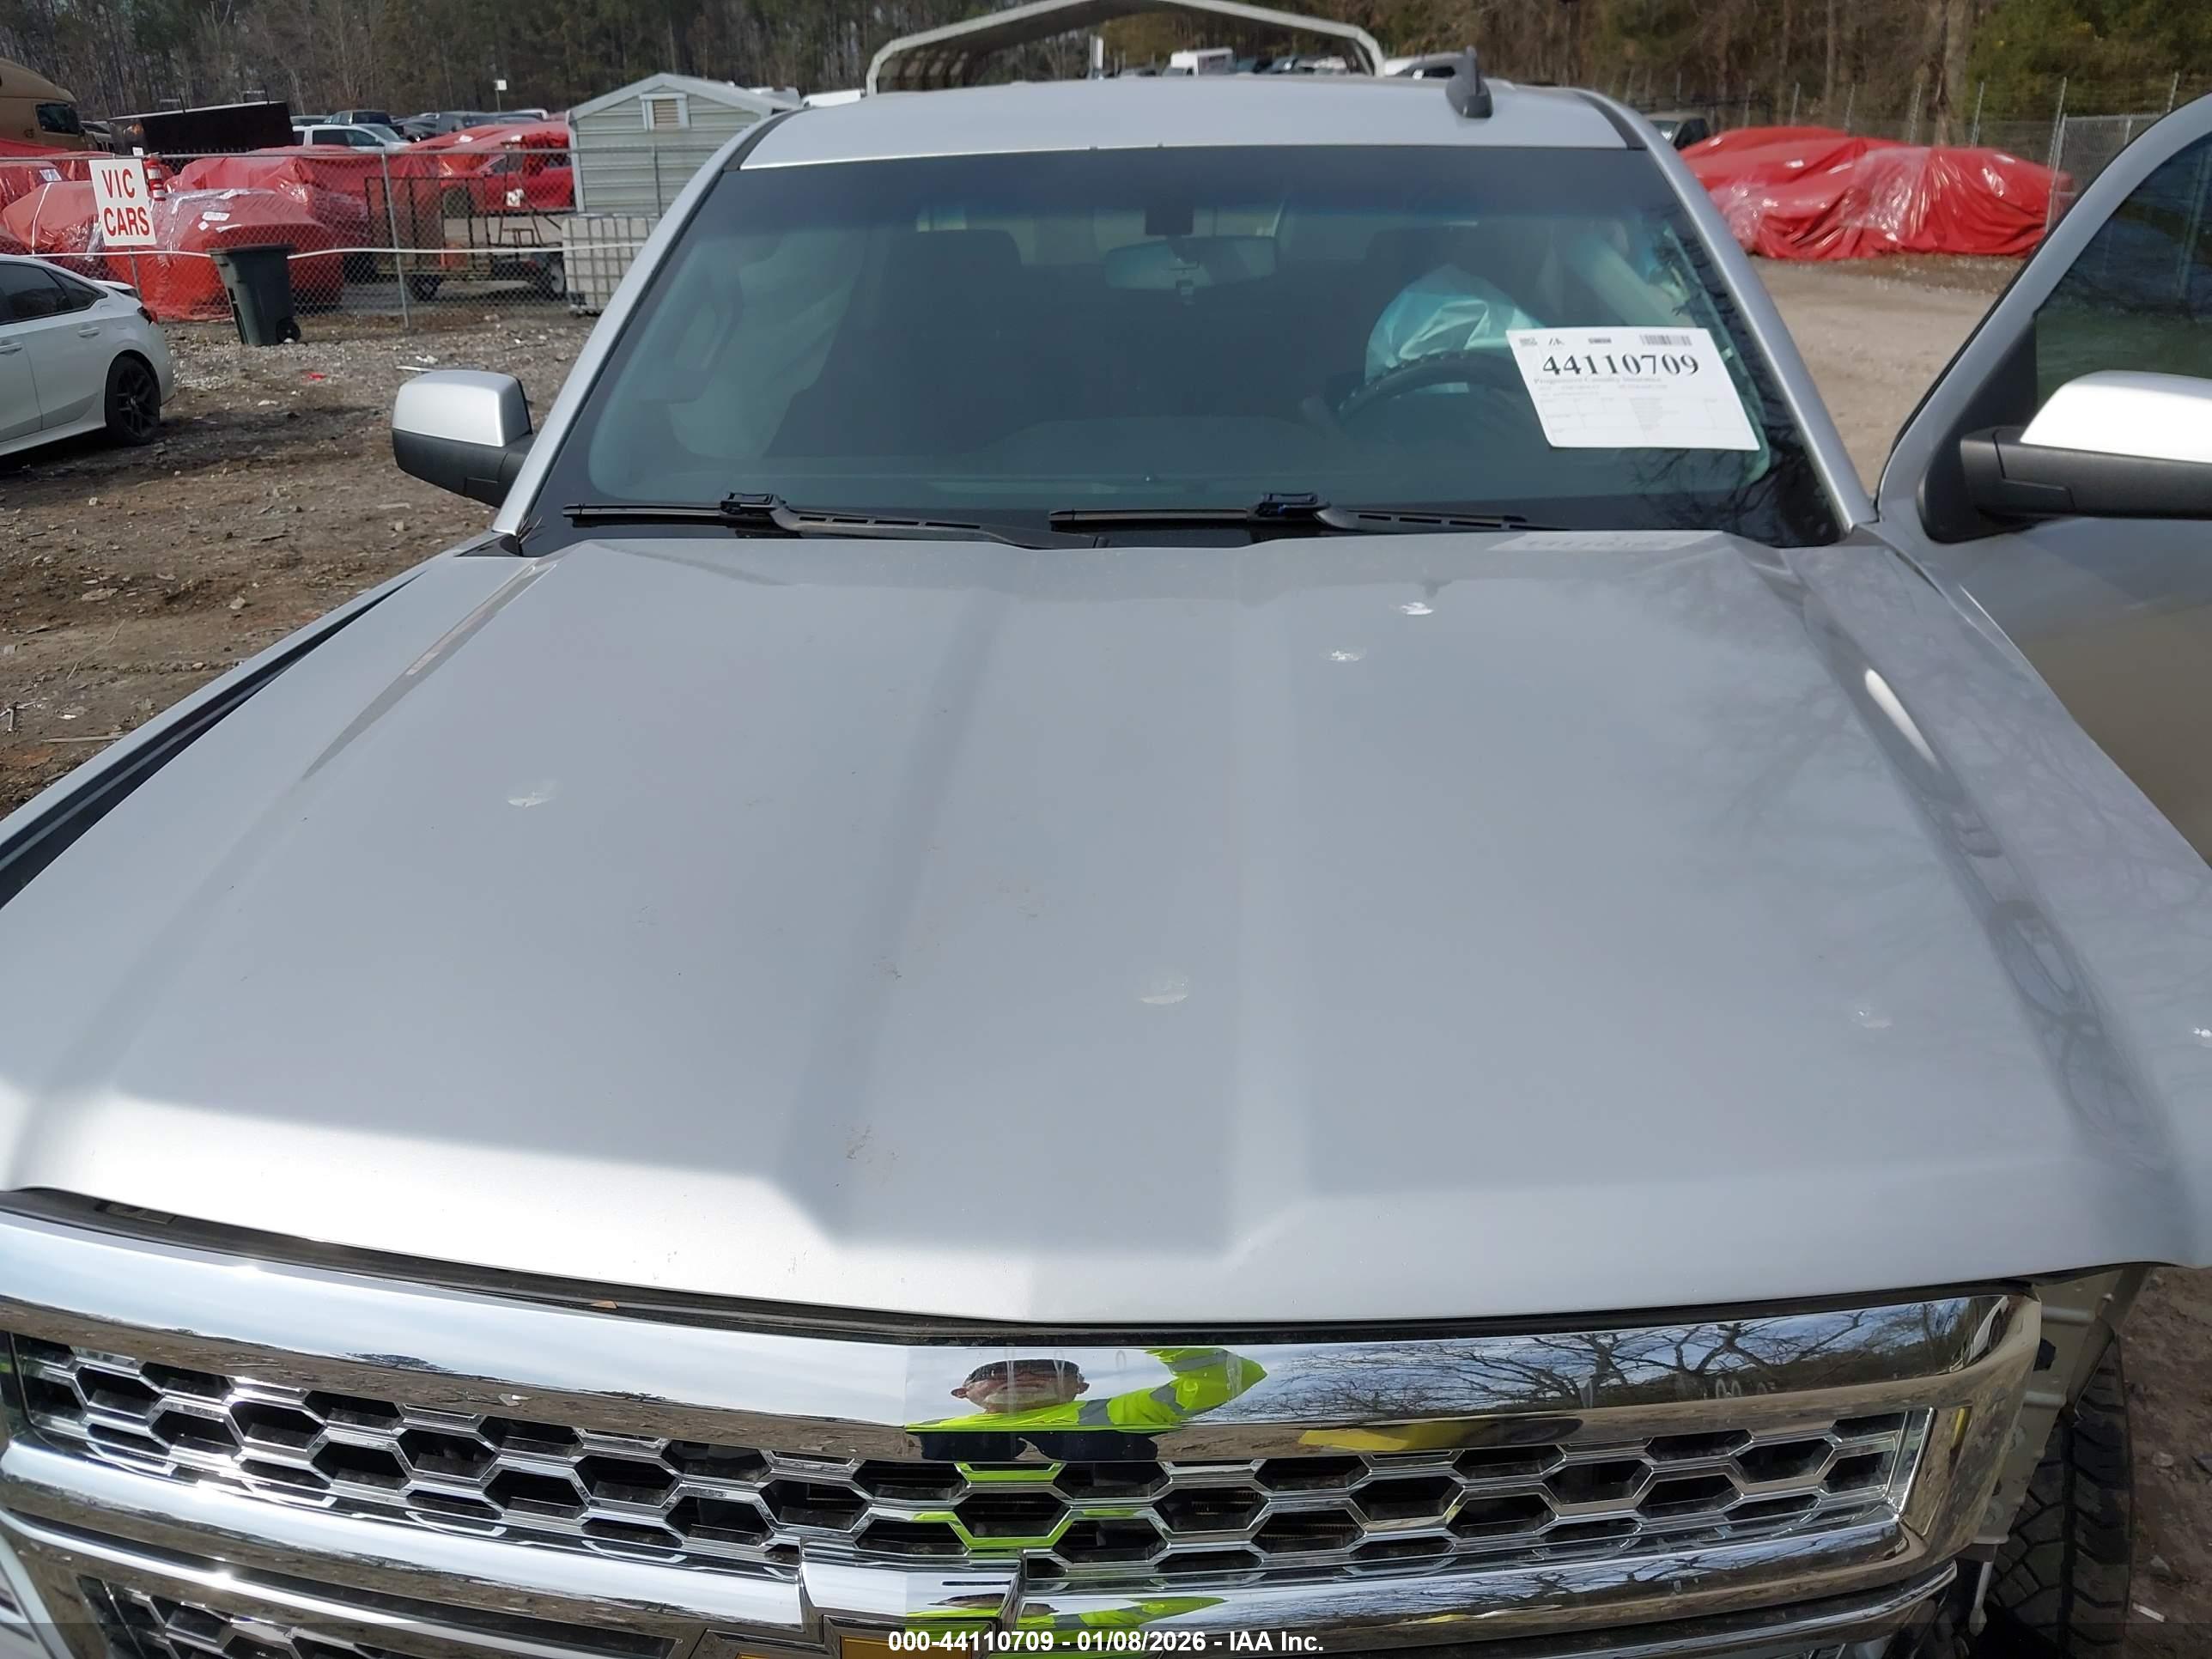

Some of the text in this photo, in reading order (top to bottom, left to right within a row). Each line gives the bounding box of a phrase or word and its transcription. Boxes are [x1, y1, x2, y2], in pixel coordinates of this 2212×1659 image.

[101, 168, 136, 198] VIC
[104, 206, 150, 236] CARS
[1542, 353, 1700, 376] 44110709
